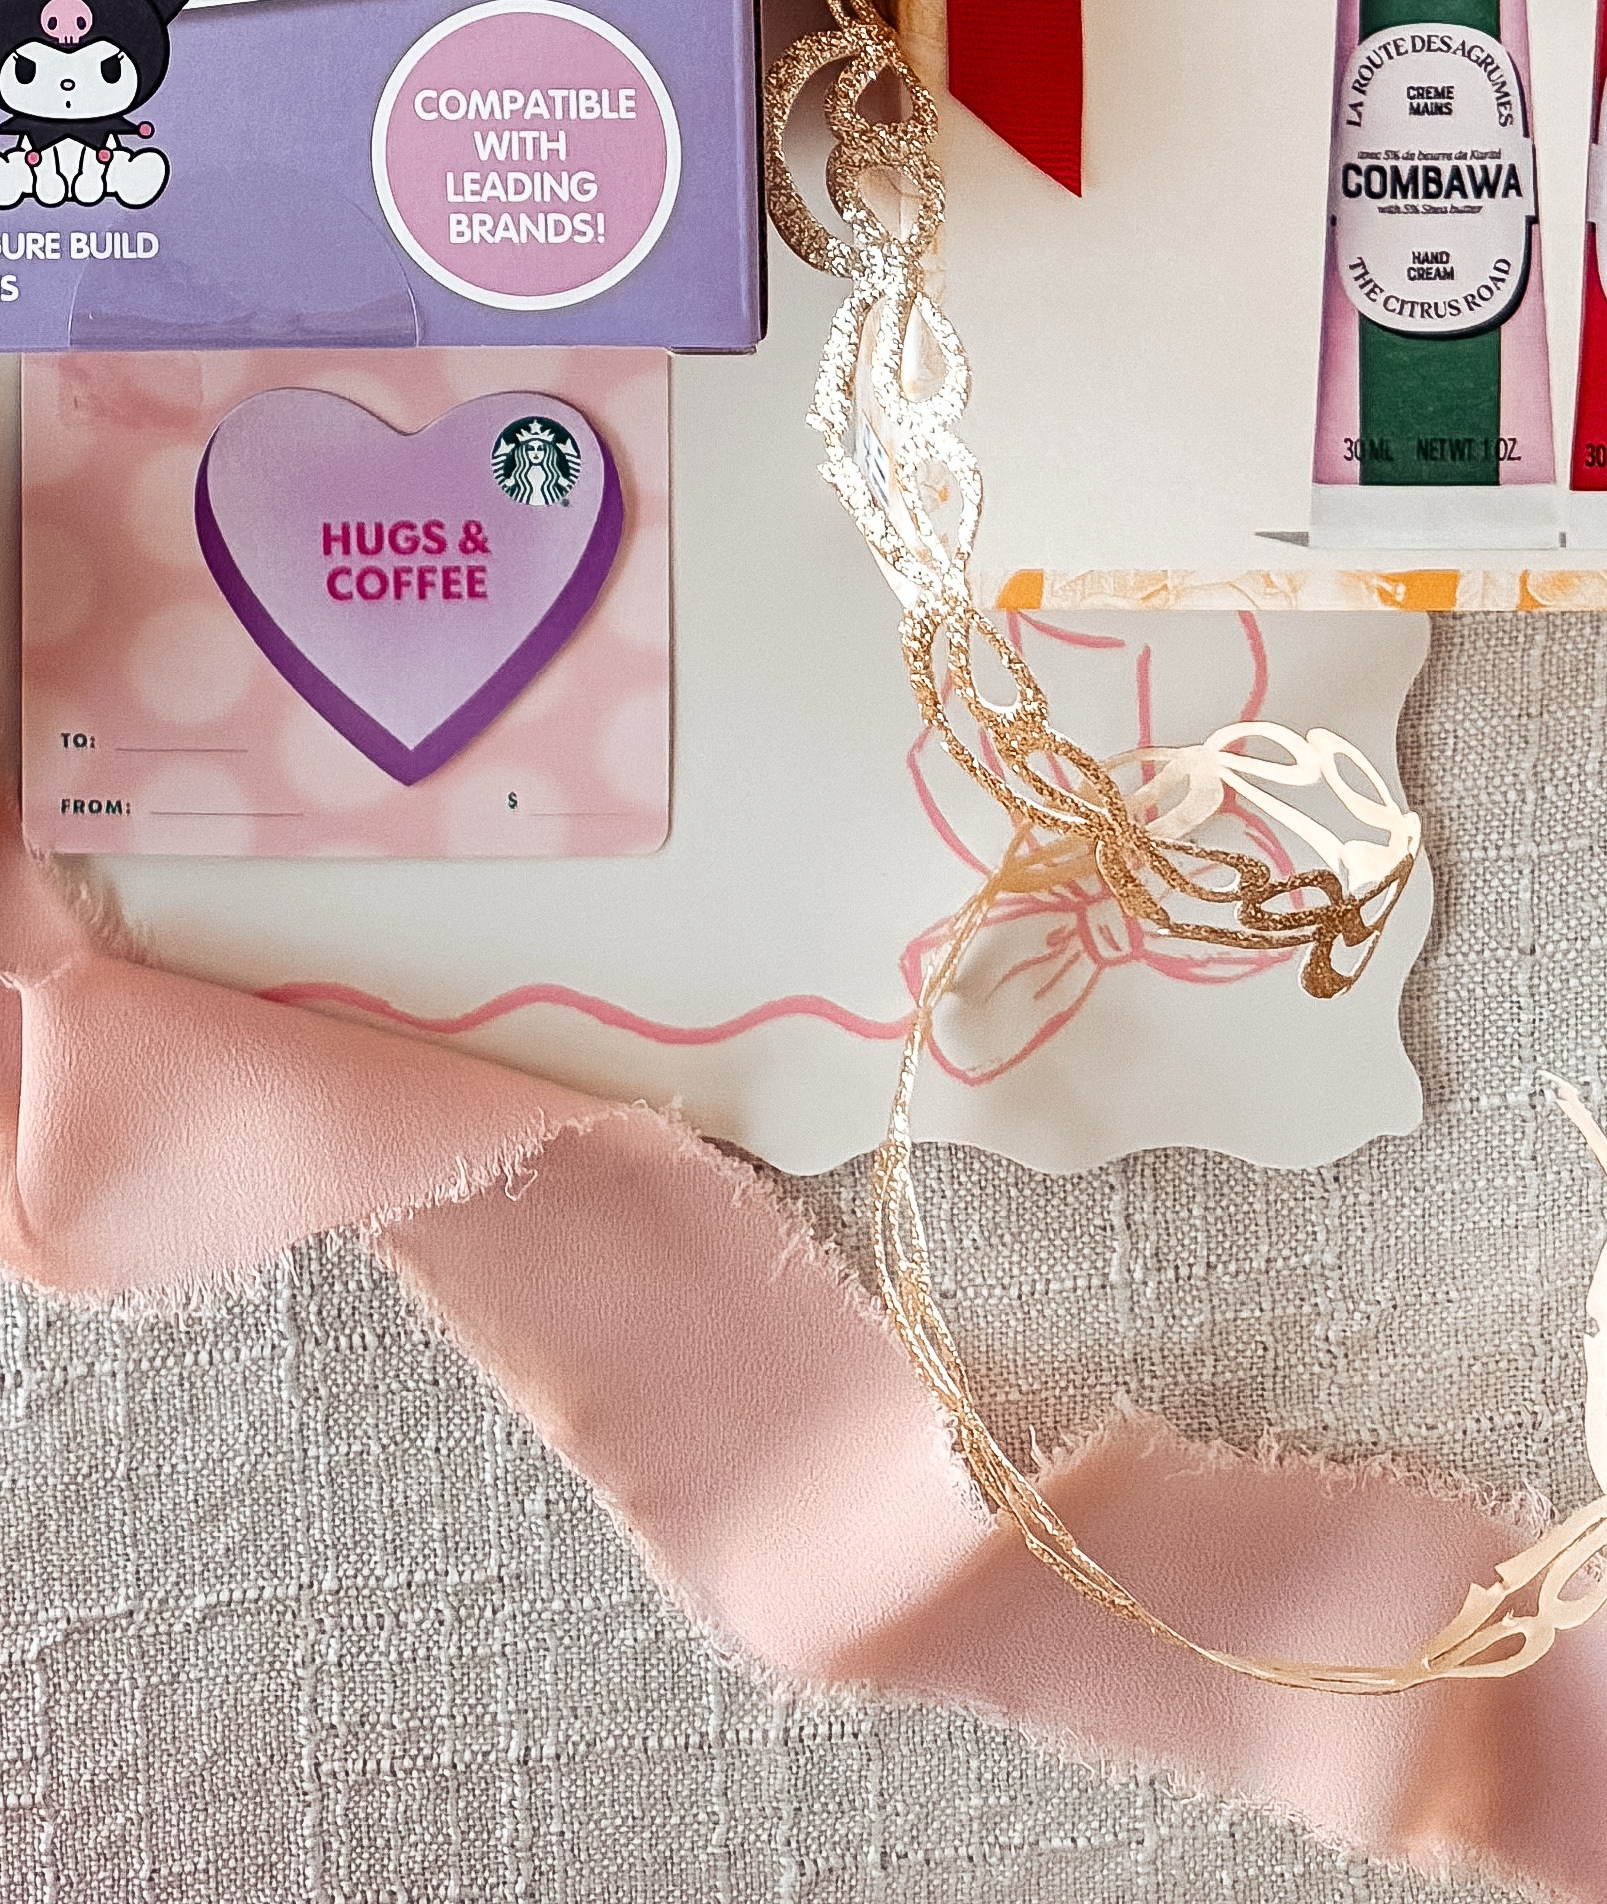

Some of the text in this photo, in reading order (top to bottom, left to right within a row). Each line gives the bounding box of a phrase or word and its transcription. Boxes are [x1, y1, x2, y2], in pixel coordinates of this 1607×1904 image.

[1346, 34, 1514, 128] LA ROUTE DES AGRUMES
[414, 86, 637, 123] COMPATIBLE
[1409, 101, 1453, 116] MAINS
[473, 129, 567, 162] WITH
[445, 170, 598, 204] LEADING
[1342, 162, 1523, 200] COMBAWA
[448, 210, 606, 245] BRANDS!
[70, 230, 159, 259] BUILD
[1411, 251, 1451, 265] HAND
[1348, 256, 1512, 320] THE CITRUS ROAD
[1406, 266, 1455, 281] CREAM
[1496, 437, 1522, 462] OZ.
[321, 519, 490, 556] HUGS &
[326, 565, 489, 601] COFFEE
[60, 733, 97, 749] TO:
[60, 799, 133, 816] FROM:
[507, 790, 519, 810] $
